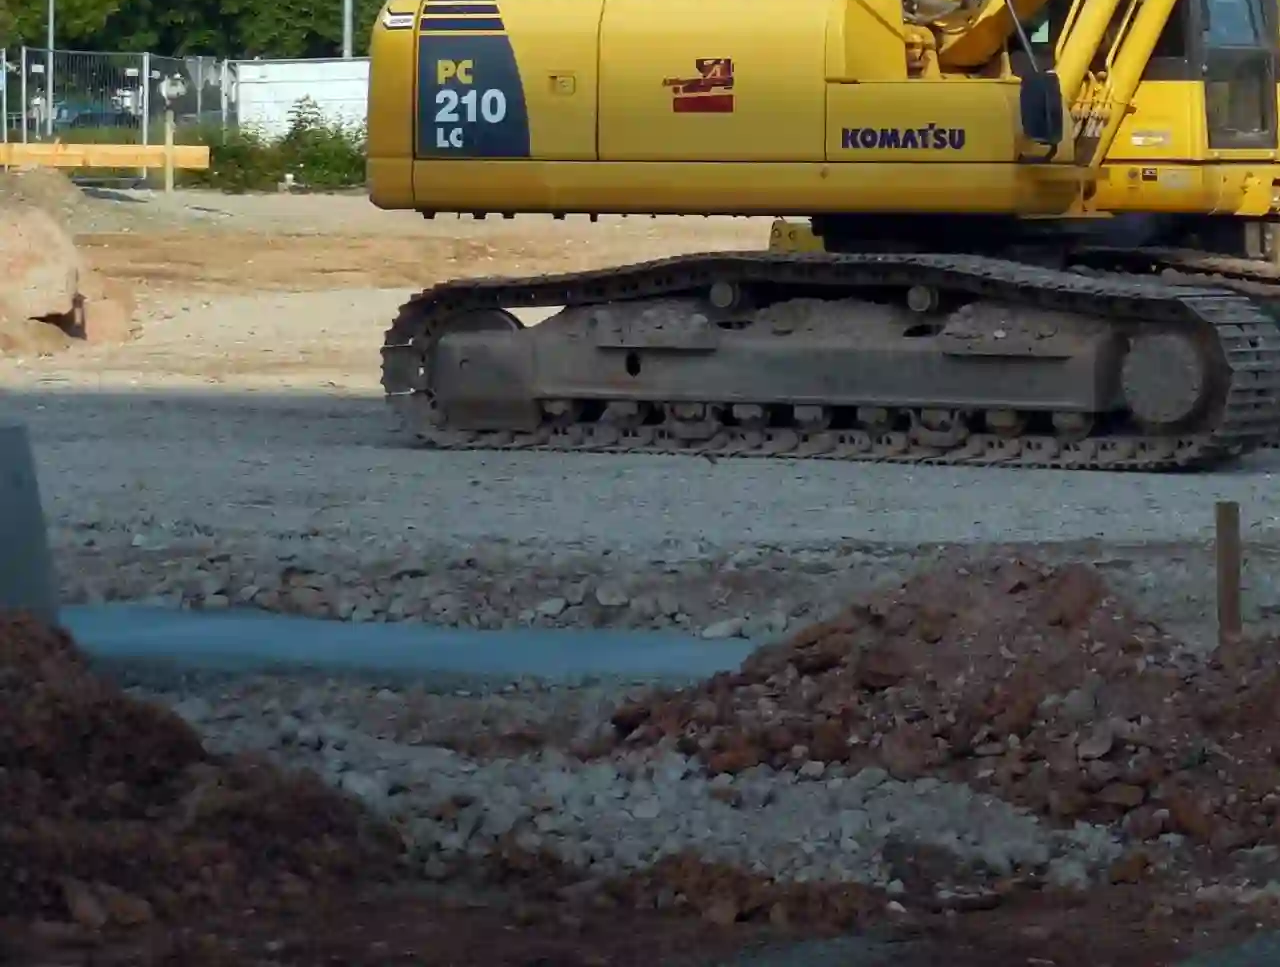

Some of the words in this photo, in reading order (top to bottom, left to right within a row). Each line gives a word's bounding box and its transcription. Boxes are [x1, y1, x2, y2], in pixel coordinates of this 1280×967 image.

[437, 59, 473, 85] PC
[435, 88, 507, 123] 210
[436, 127, 463, 148] LC
[841, 122, 966, 150] KOMATSU
